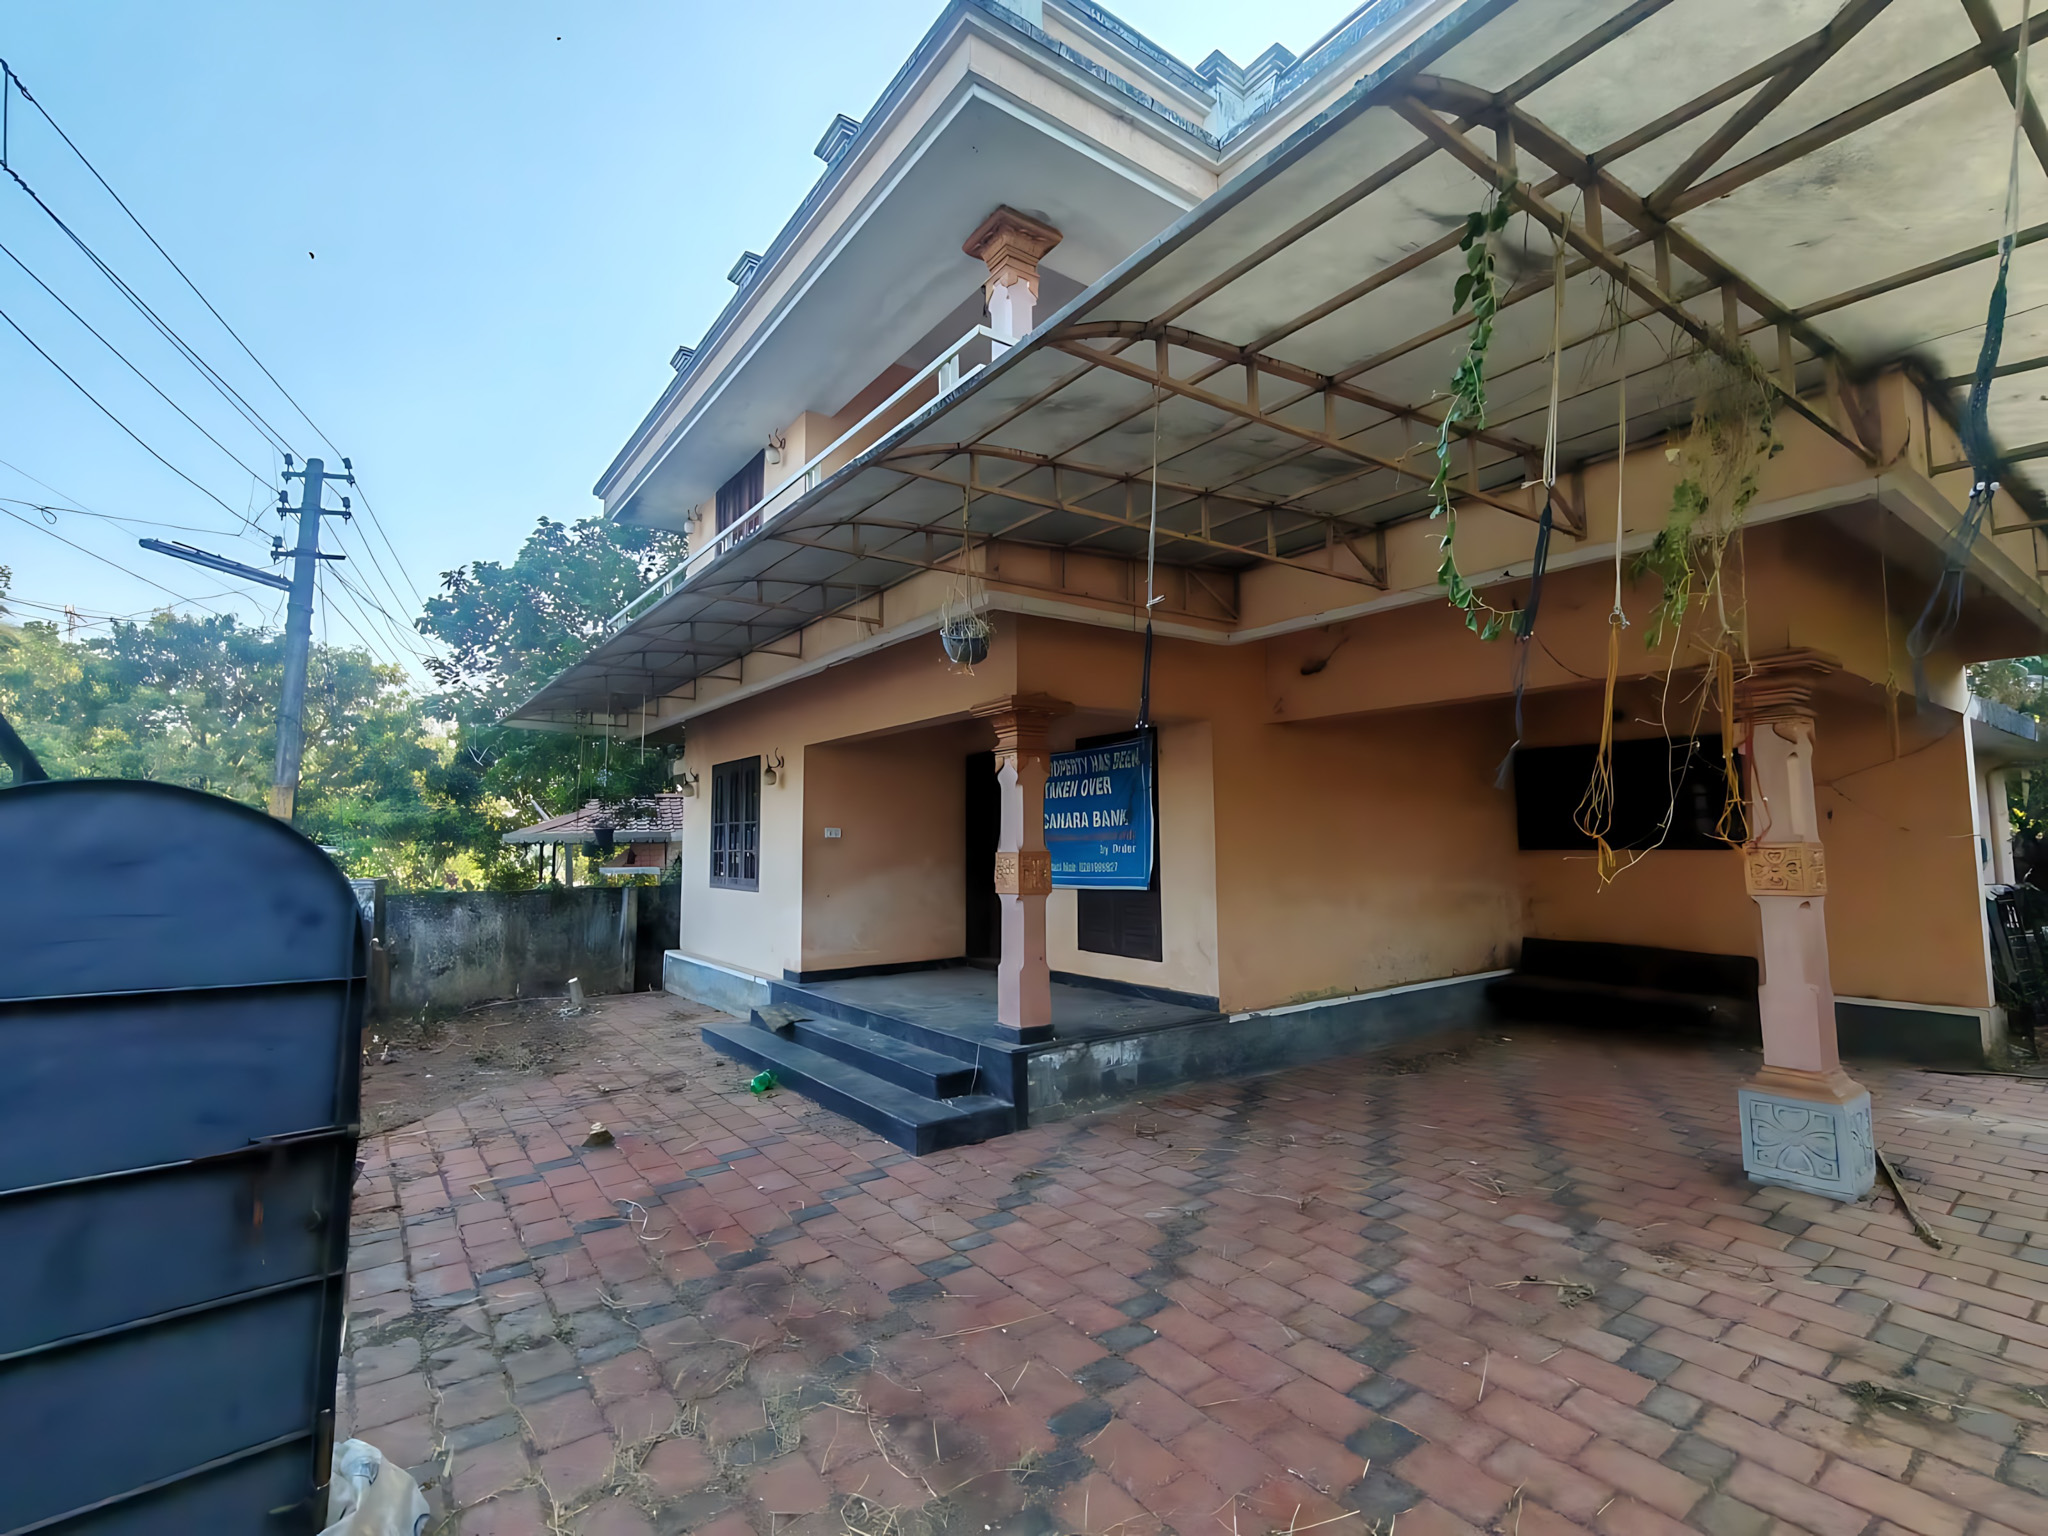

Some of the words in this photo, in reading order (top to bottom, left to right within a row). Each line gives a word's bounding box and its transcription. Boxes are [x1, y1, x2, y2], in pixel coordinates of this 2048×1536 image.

[1090, 753, 1112, 773] HAS
[1081, 776, 1112, 797] OVER
[1093, 809, 1129, 828] BANK
